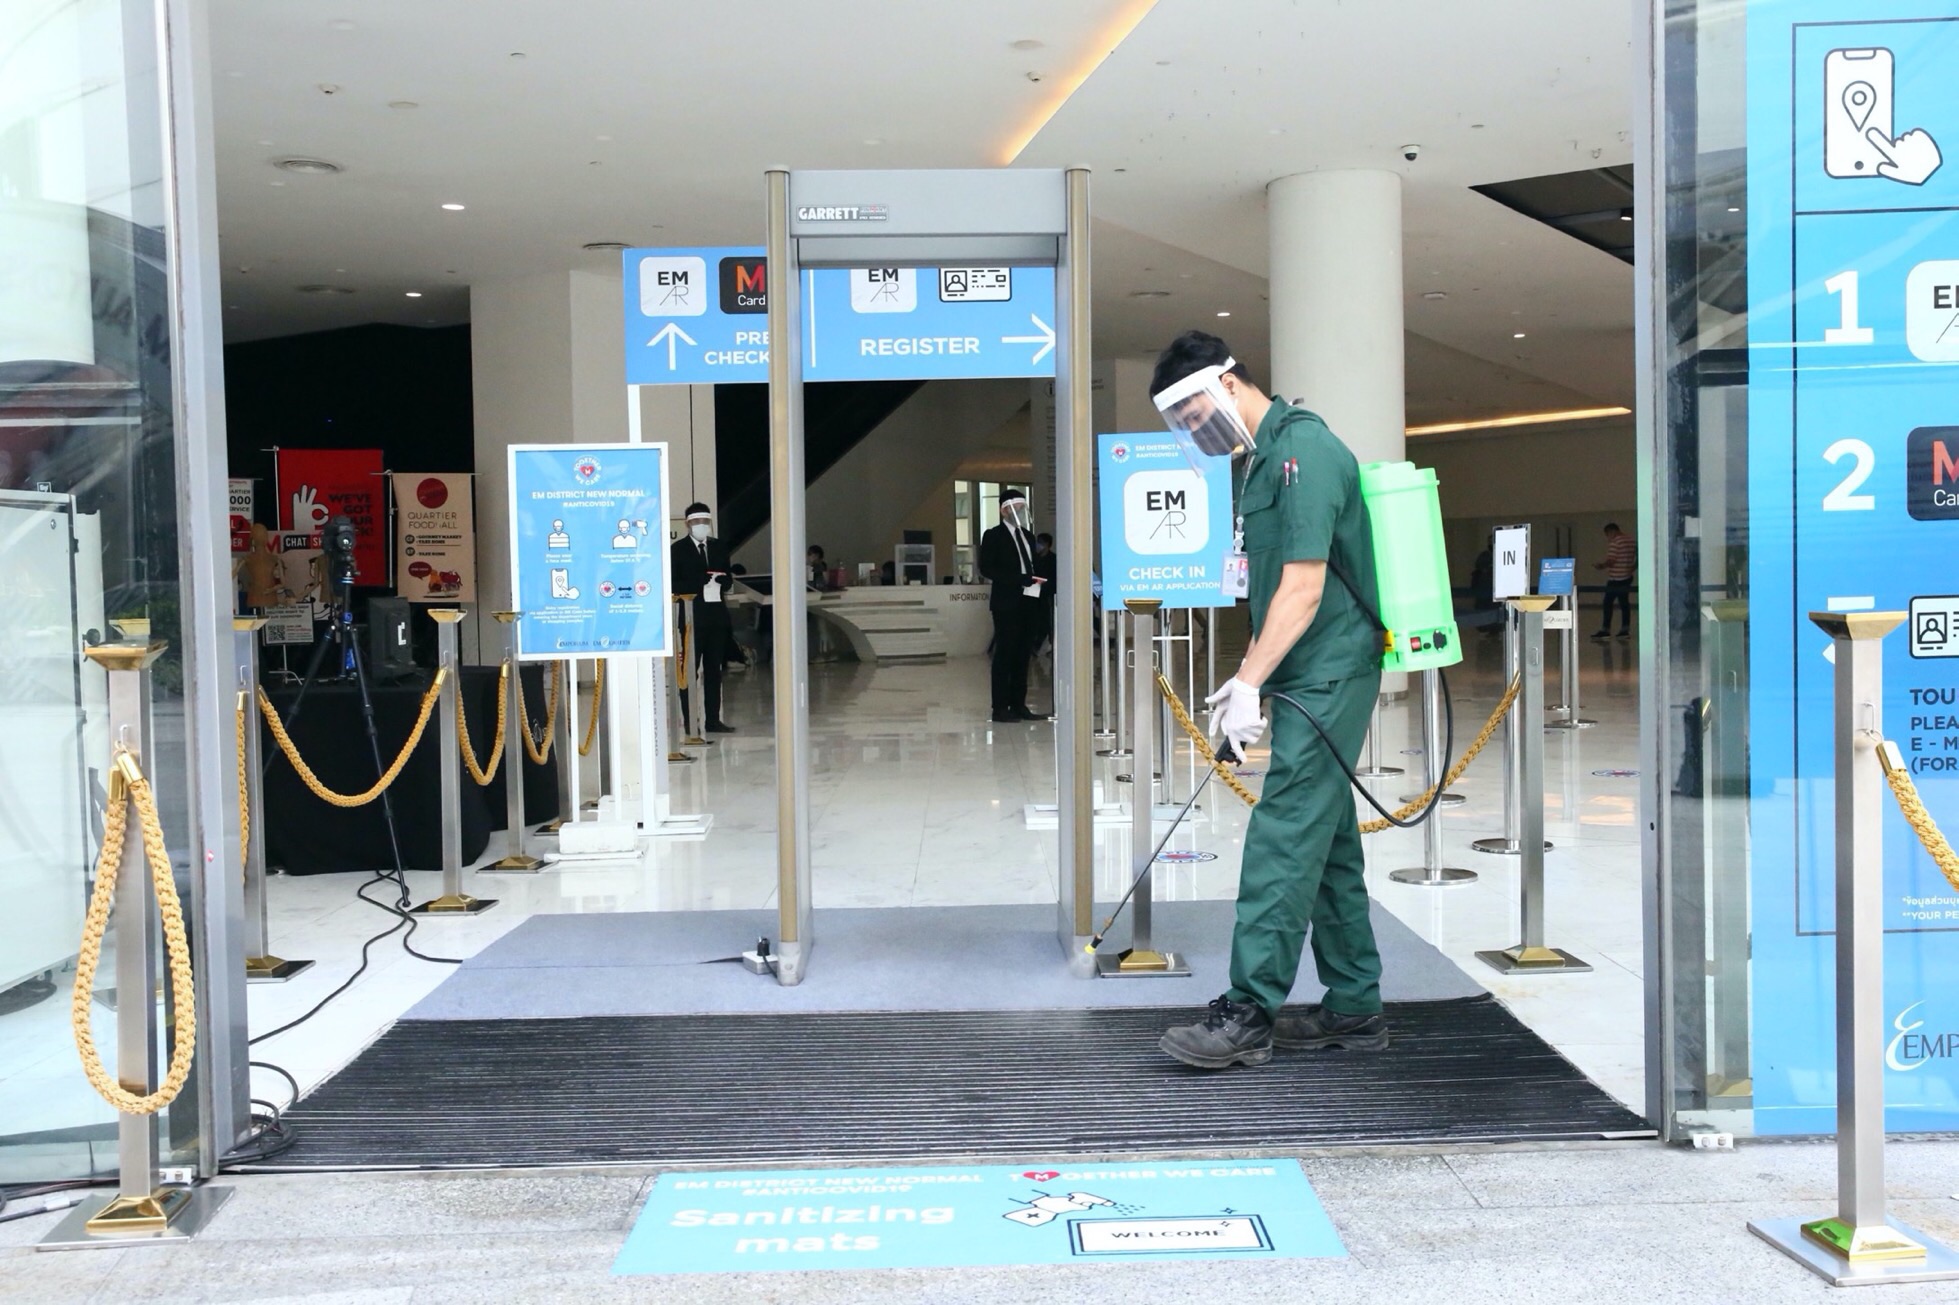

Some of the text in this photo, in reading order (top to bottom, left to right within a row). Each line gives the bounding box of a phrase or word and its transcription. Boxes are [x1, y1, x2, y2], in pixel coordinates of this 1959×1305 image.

[799, 207, 859, 220] GARRETT
[658, 271, 689, 286] EM
[736, 264, 766, 293] M
[868, 268, 899, 282] EM
[737, 295, 766, 306] Card
[1825, 270, 1874, 343] 1
[860, 337, 981, 356] REGISTER
[704, 350, 770, 365] CHECK
[1822, 438, 1875, 511] 2
[532, 489, 645, 499] EM DISTRICT NEW NORMAL
[1146, 490, 1186, 511] EM
[563, 500, 615, 508] #ANTICOVID19
[408, 511, 457, 520] QUARTIER
[285, 537, 307, 547] CHAT
[1503, 550, 1516, 565] IN
[1129, 565, 1206, 581] CHECK IN
[1120, 584, 1135, 592] VIA
[1151, 583, 1164, 591] AR
[1166, 581, 1220, 591] APPLICATION
[1911, 756, 1958, 775] (FOR
[1164, 1169, 1204, 1178] WE
[1209, 1167, 1277, 1177] CARE
[674, 1174, 984, 1190] EM DISTRICT NEW NORMAL
[741, 1184, 914, 1196] #ANTICOVID19
[670, 1204, 955, 1228] Sanitizing
[1112, 1230, 1226, 1239] WELCOME
[734, 1232, 881, 1254] mats
